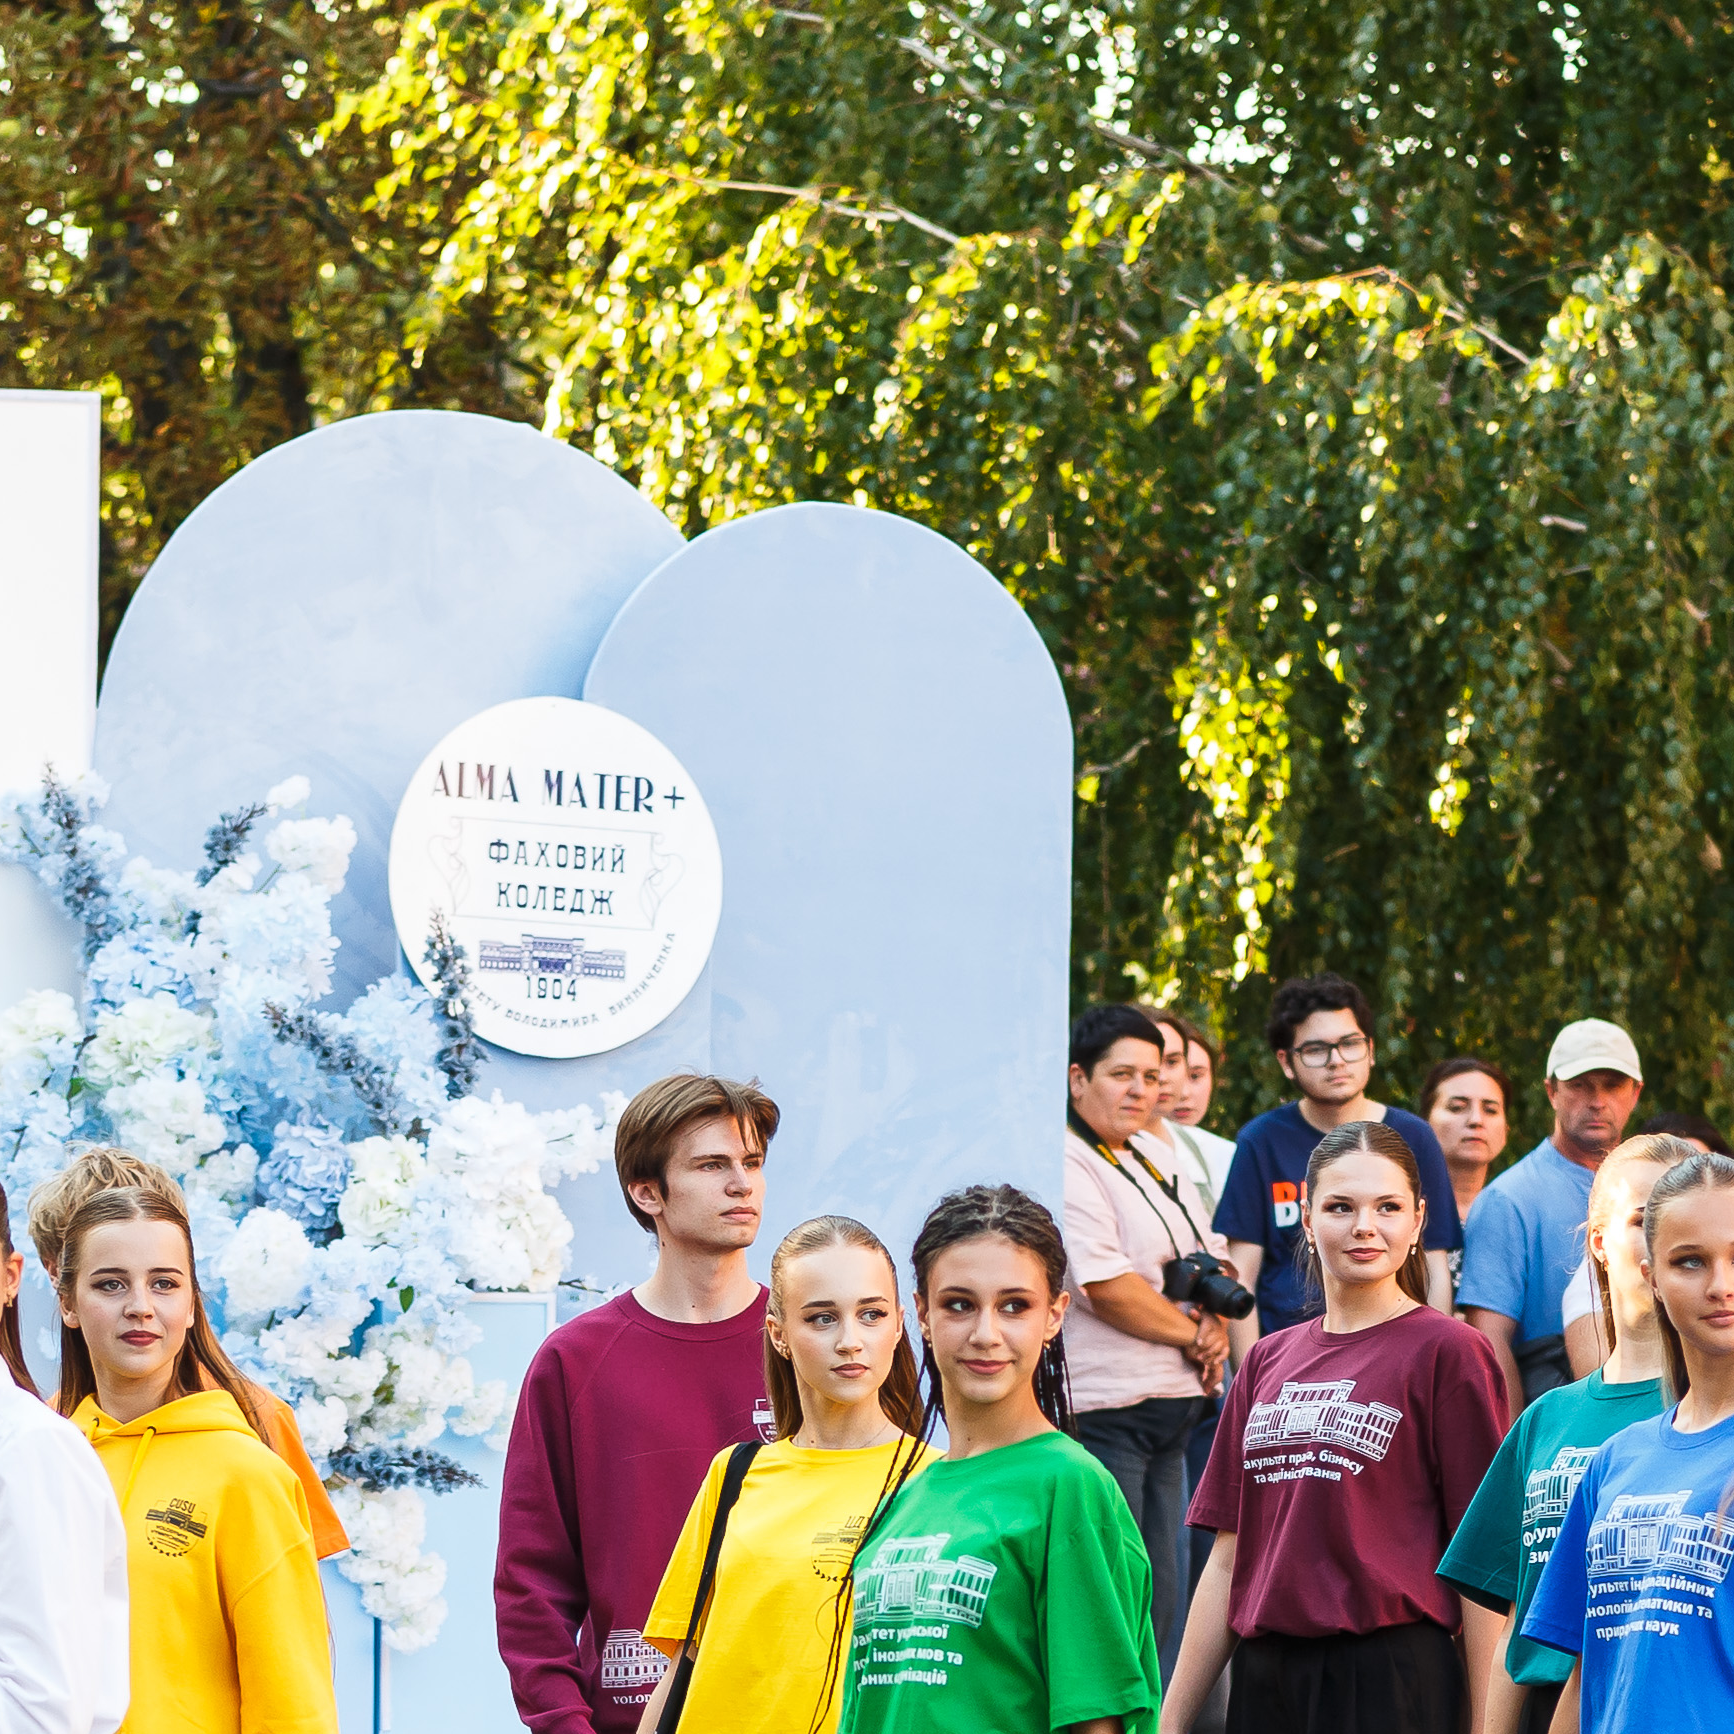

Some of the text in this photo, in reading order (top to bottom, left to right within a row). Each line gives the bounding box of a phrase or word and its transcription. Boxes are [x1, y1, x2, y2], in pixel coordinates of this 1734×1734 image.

[431, 760, 520, 804] ALMA
[488, 838, 627, 875] ФАХОВИЙ
[496, 882, 614, 916] КОЛЕДЖ
[1319, 1450, 1364, 1476] бізнесу
[1254, 1475, 1266, 1484] та
[169, 1498, 196, 1514] CUSU
[1696, 1605, 1713, 1619] та
[1645, 1620, 1680, 1637] наук
[947, 1651, 963, 1665] та
[613, 1694, 652, 1704] VOLOD
